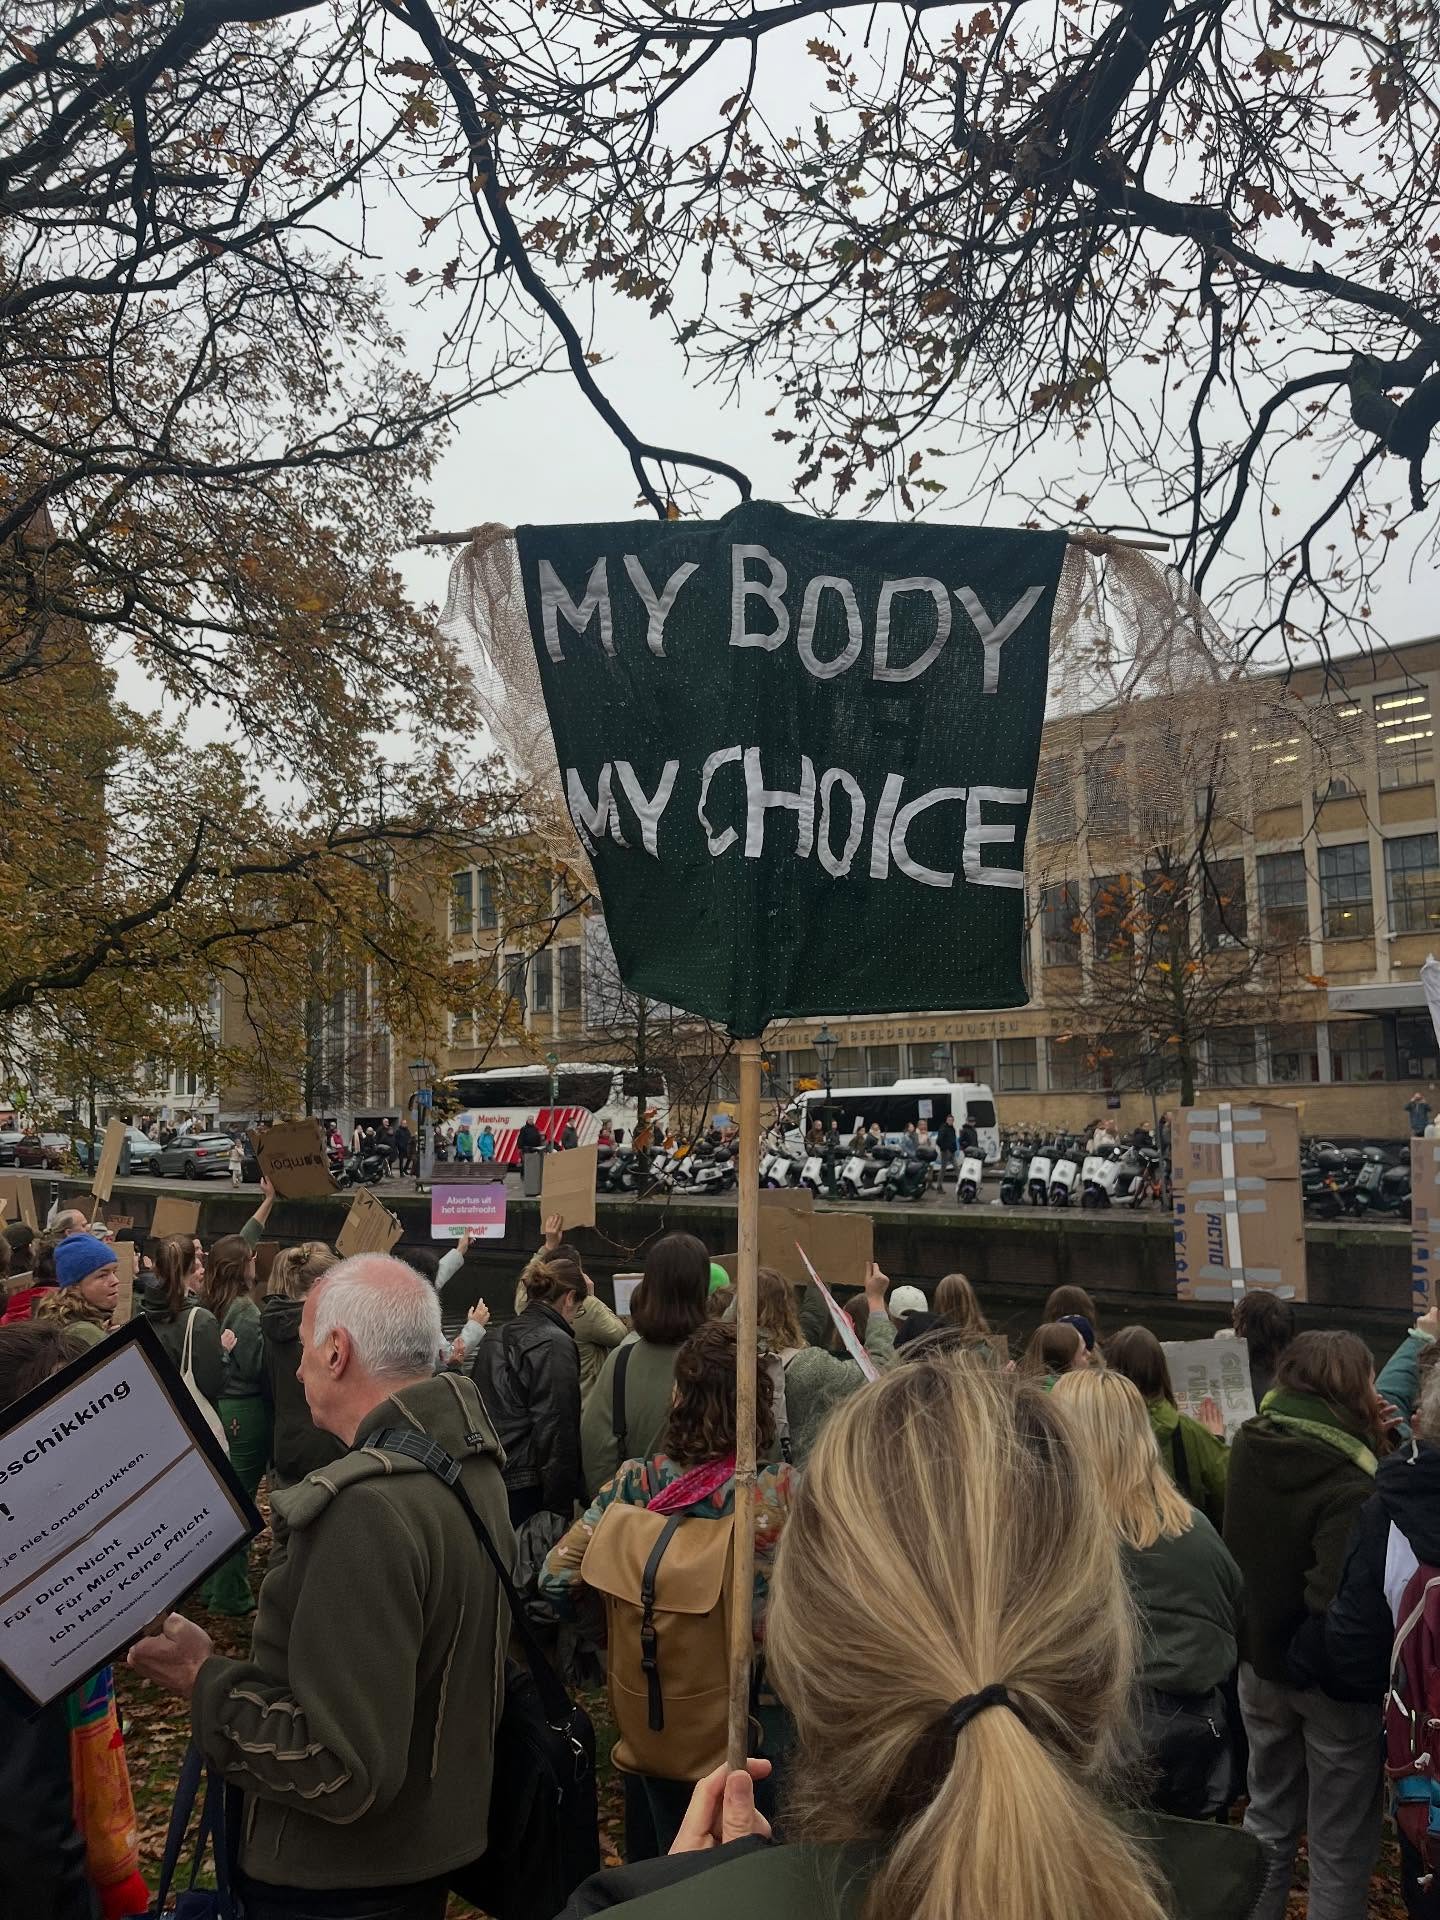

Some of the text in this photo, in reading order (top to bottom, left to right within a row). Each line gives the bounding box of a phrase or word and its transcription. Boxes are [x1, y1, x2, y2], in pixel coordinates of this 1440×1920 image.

[539, 544, 1045, 693] MY BODY
[566, 745, 1028, 889] MY CHOICE
[442, 1206, 455, 1214] het
[446, 1196, 480, 1205] Abortus
[1206, 1213, 1225, 1266] ACTIO
[4, 1538, 123, 1628] Für Dich Nicht
[20, 1529, 49, 1552] niet
[49, 1622, 76, 1644] Ich
[118, 1552, 162, 1591] Keine
[163, 1507, 210, 1551] Pflicht
[55, 1522, 169, 1616] Für Mich Nicht
